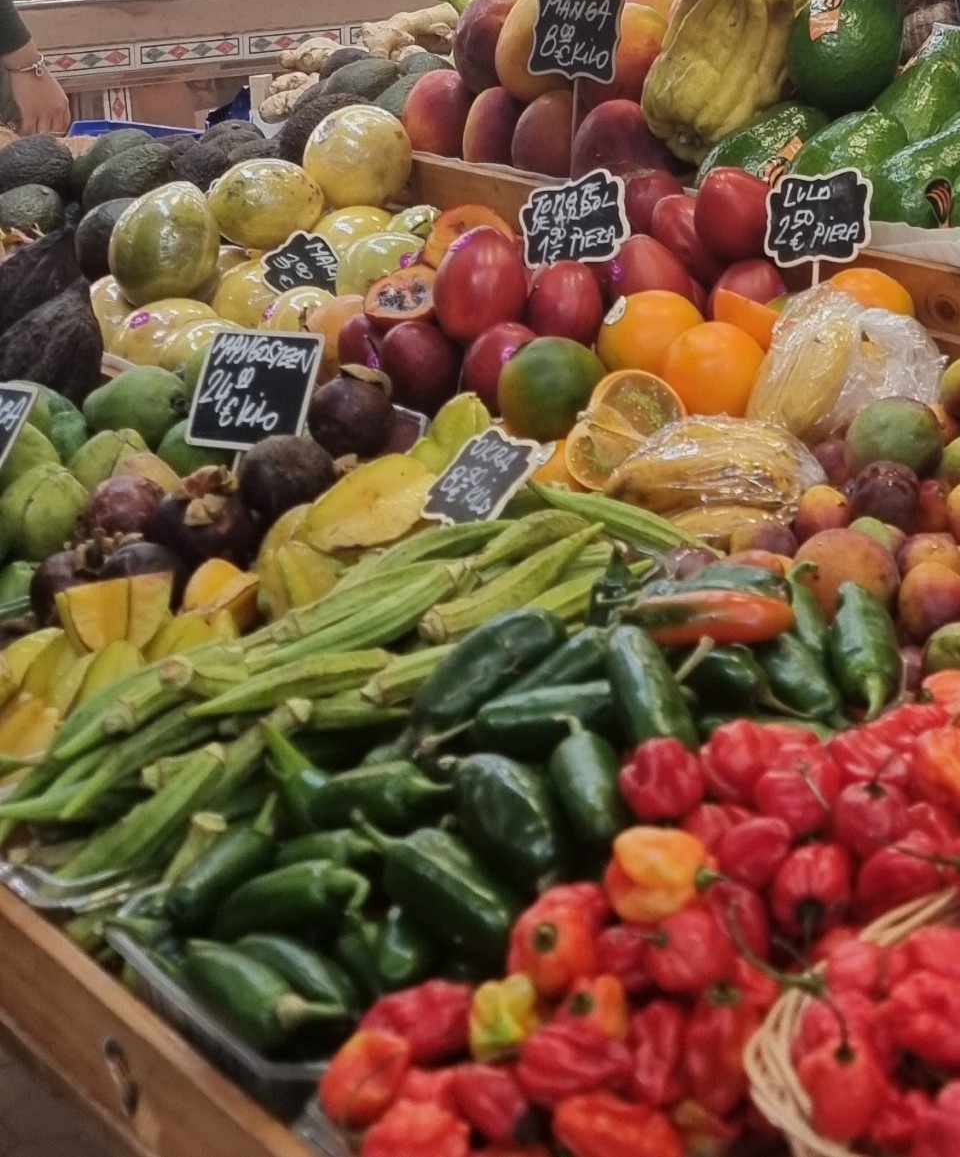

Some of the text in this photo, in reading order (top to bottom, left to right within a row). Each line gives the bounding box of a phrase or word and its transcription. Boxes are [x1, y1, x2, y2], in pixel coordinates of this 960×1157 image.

[533, 181, 602, 221] TOMATE
[783, 182, 831, 208] LULO
[469, 438, 519, 473] OKRA
